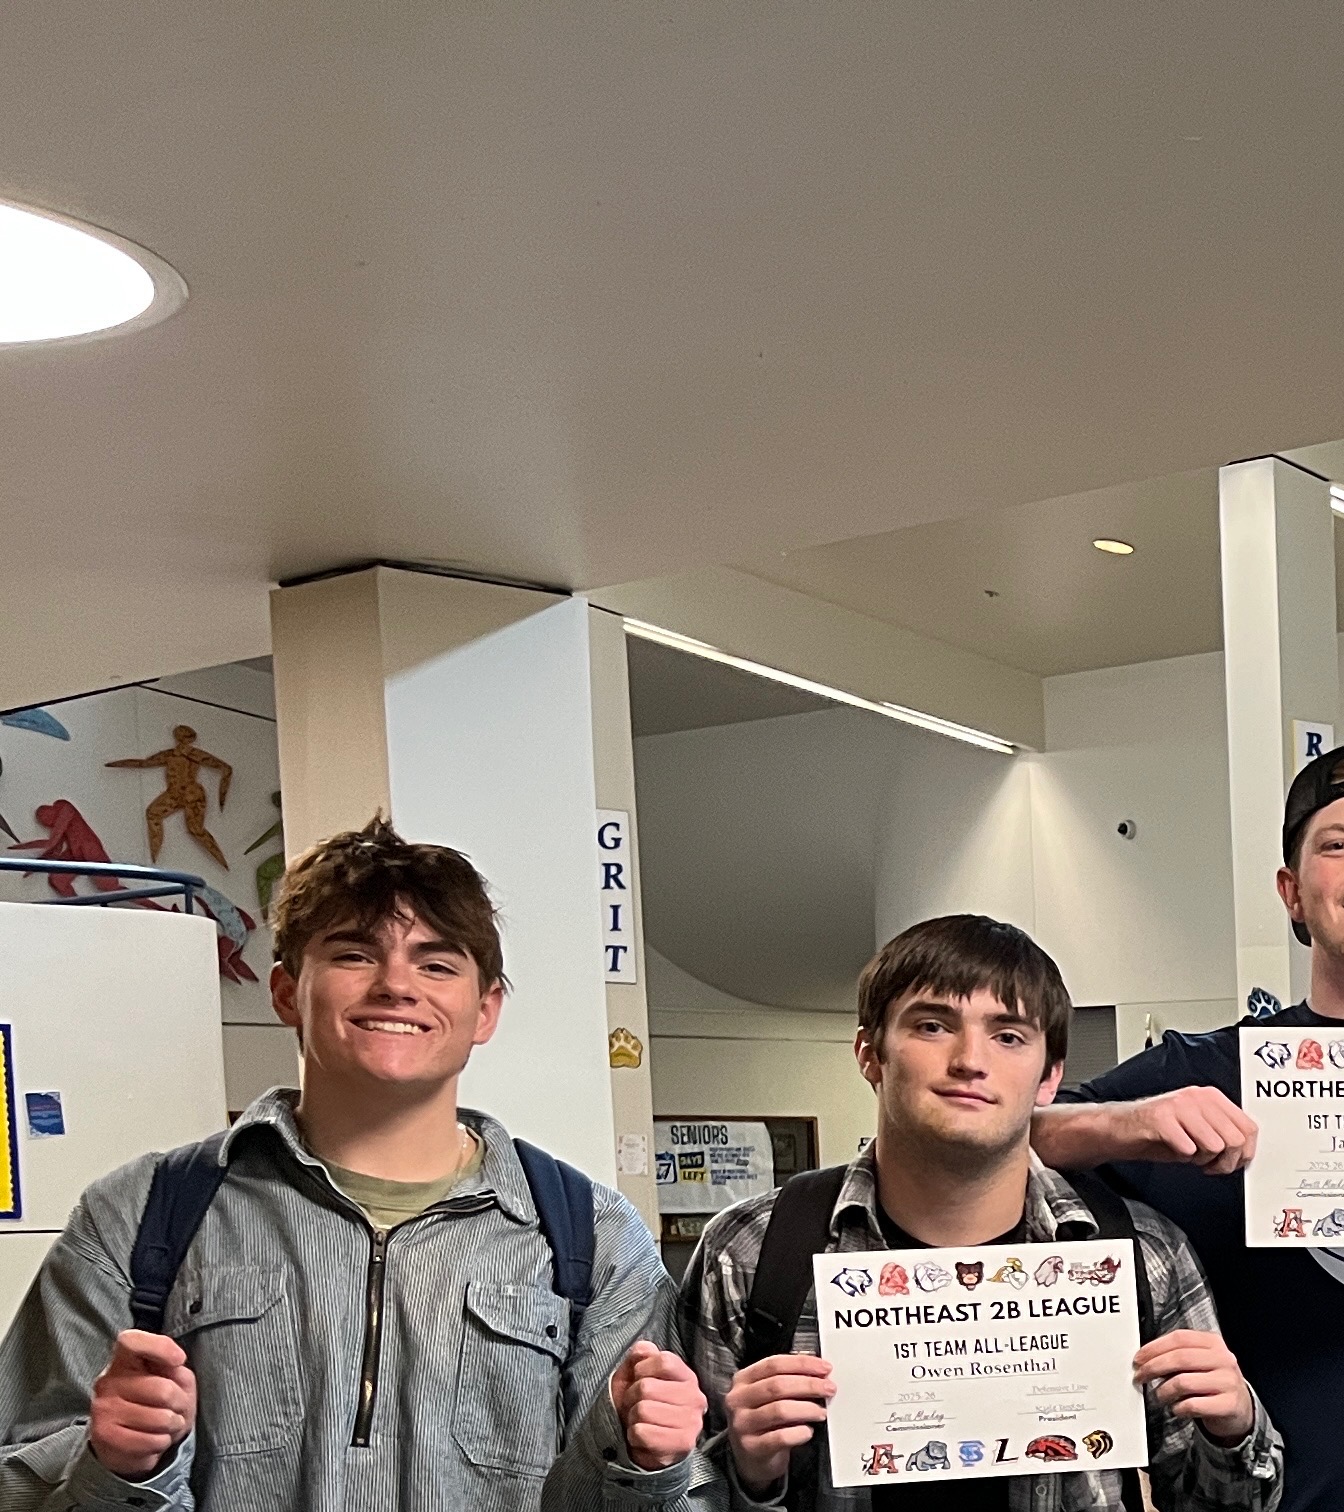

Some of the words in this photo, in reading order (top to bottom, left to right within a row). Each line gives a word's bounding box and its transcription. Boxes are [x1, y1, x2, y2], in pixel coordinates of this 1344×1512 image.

[597, 821, 628, 973] GRIT
[1308, 1115, 1329, 1129] 1ST
[671, 1125, 728, 1145] SENIORS
[683, 1170, 705, 1181] LEFT
[835, 1303, 982, 1329] NORTHEAST
[990, 1301, 1021, 1320] 2B
[1029, 1295, 1120, 1317] LEAGUE
[894, 1342, 918, 1359] 1ST
[924, 1340, 967, 1357] TEAM
[974, 1334, 1069, 1354] ALL-LEAGUE
[912, 1366, 963, 1381] Owen
[971, 1358, 1056, 1377] Rosenthal
